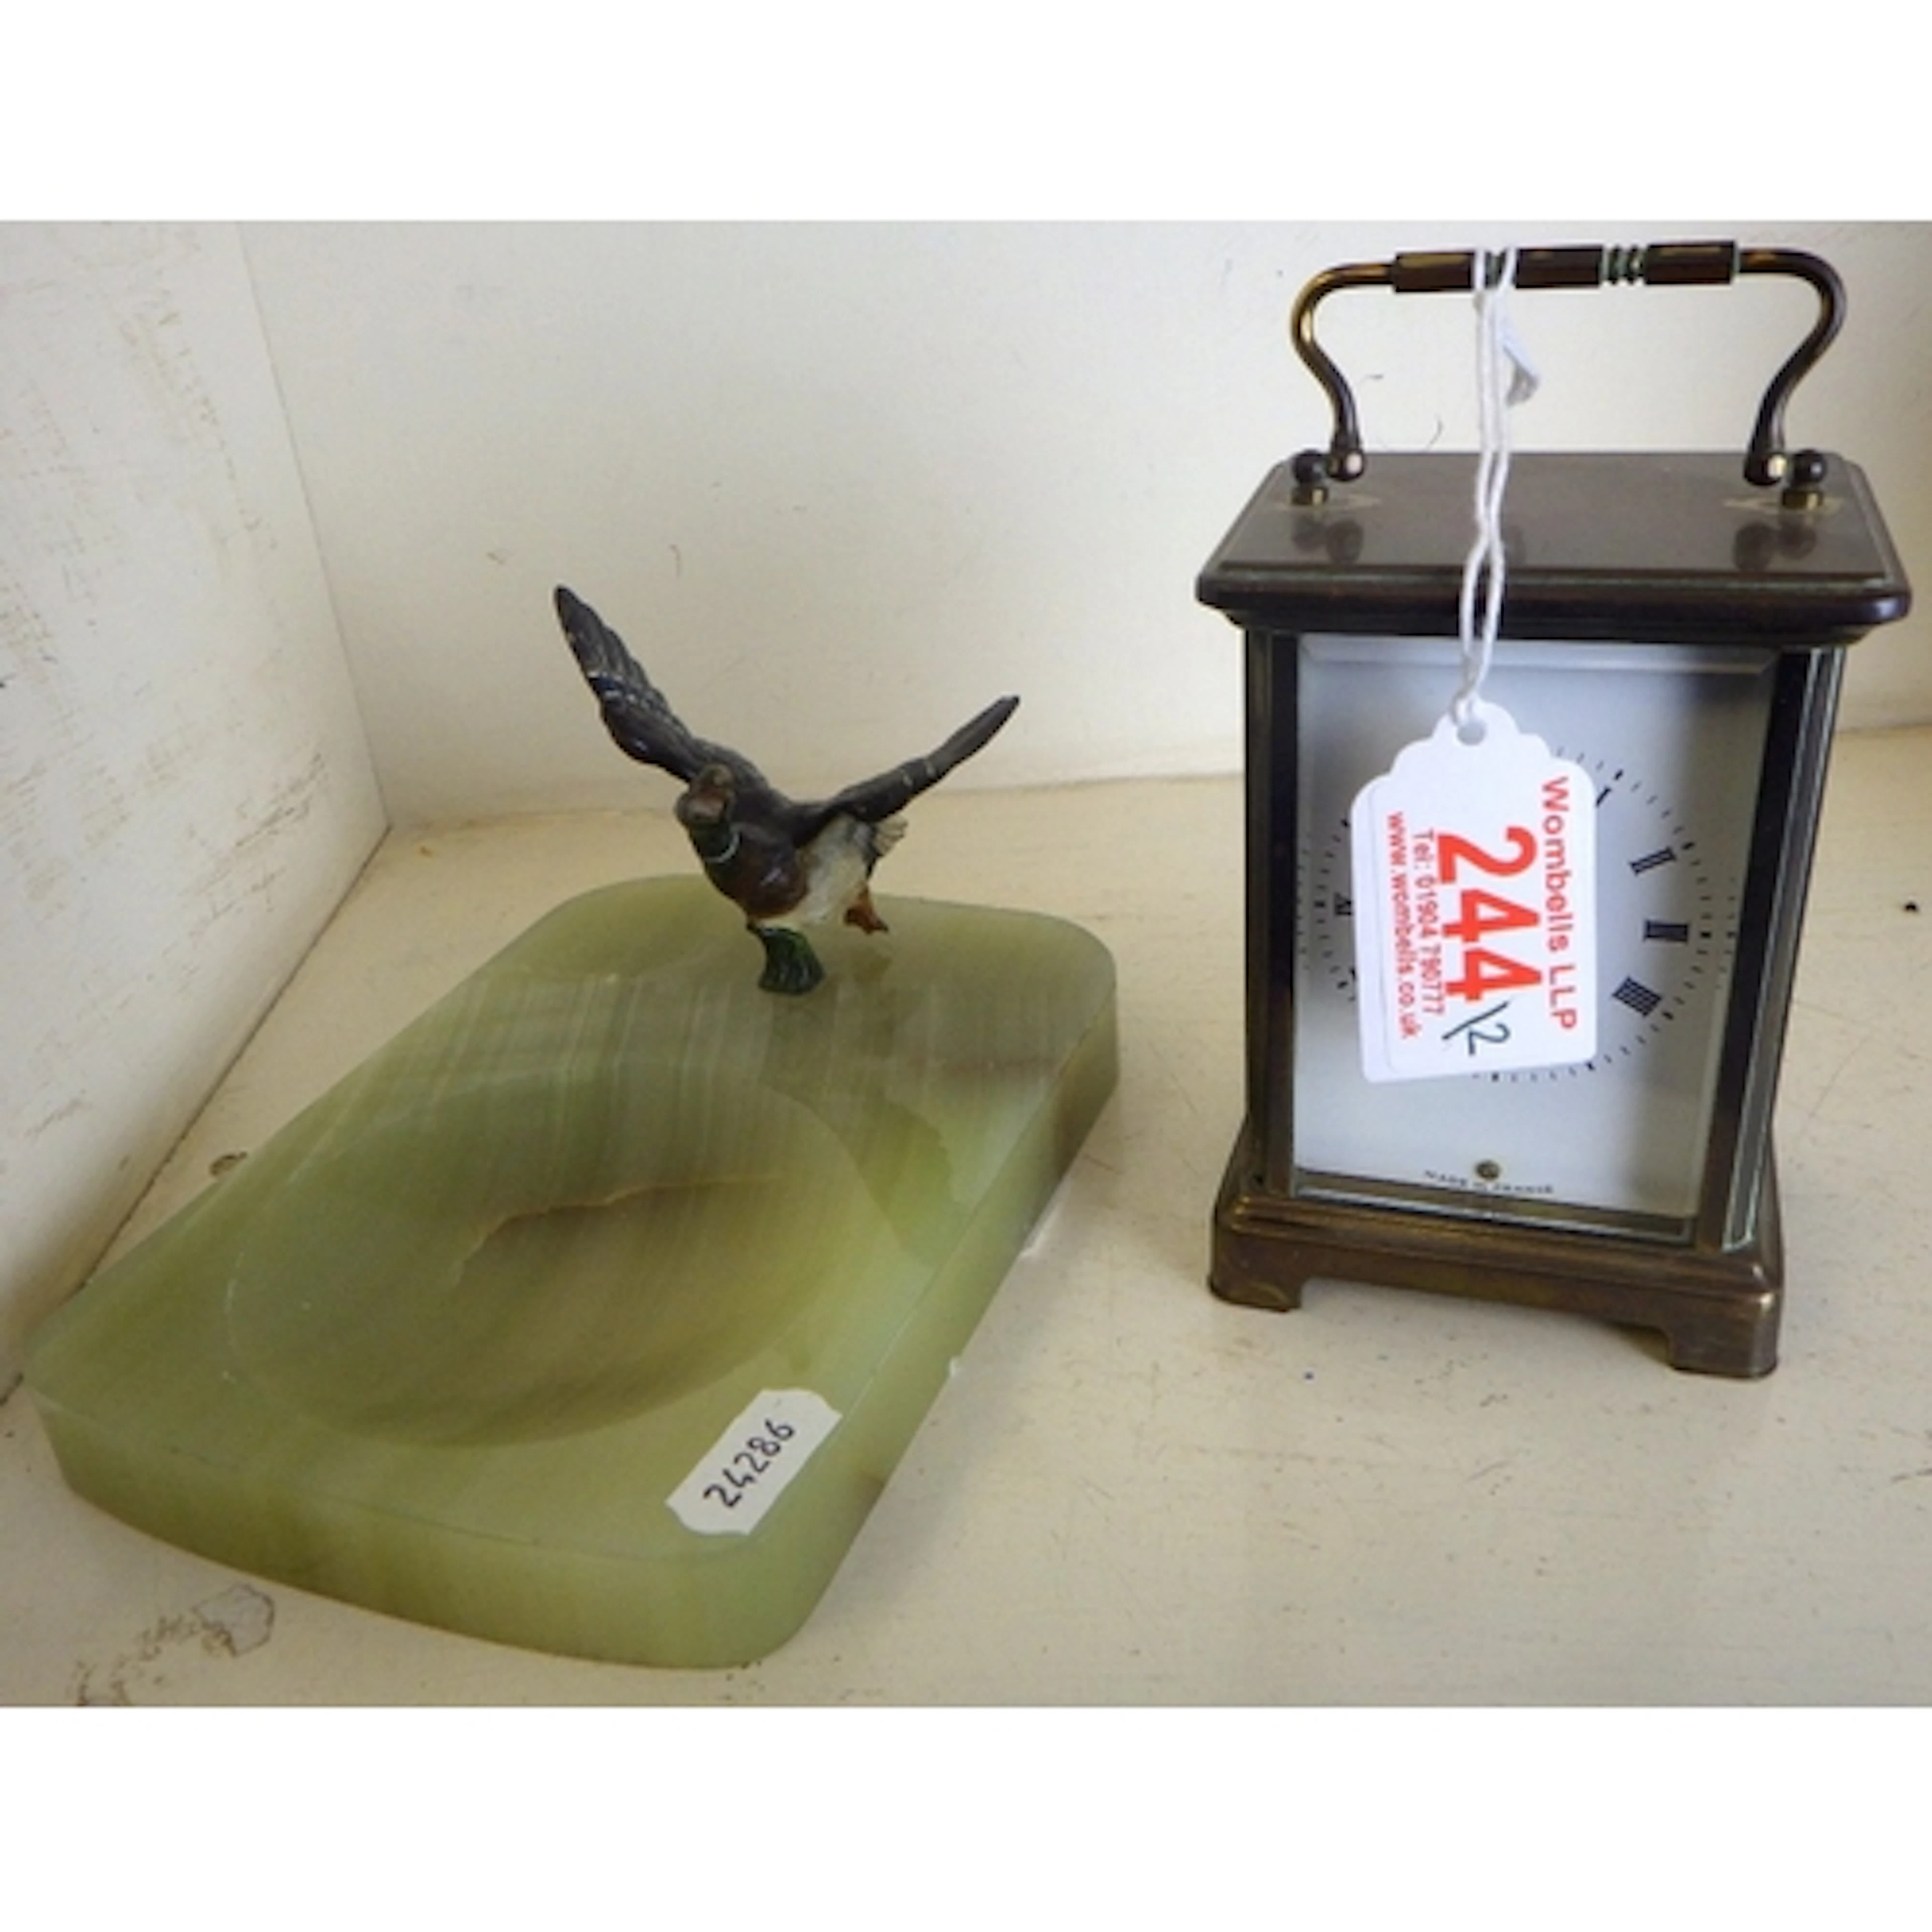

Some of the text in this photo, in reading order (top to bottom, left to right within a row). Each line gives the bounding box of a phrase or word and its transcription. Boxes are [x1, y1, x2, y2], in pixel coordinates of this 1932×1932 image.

[1414, 827, 1435, 869] Tel:
[1415, 874, 1438, 939] 01904
[1437, 825, 1542, 1002] 244
[1542, 776, 1577, 1029] Wombells LLP
[704, 1418, 795, 1508] 24286
